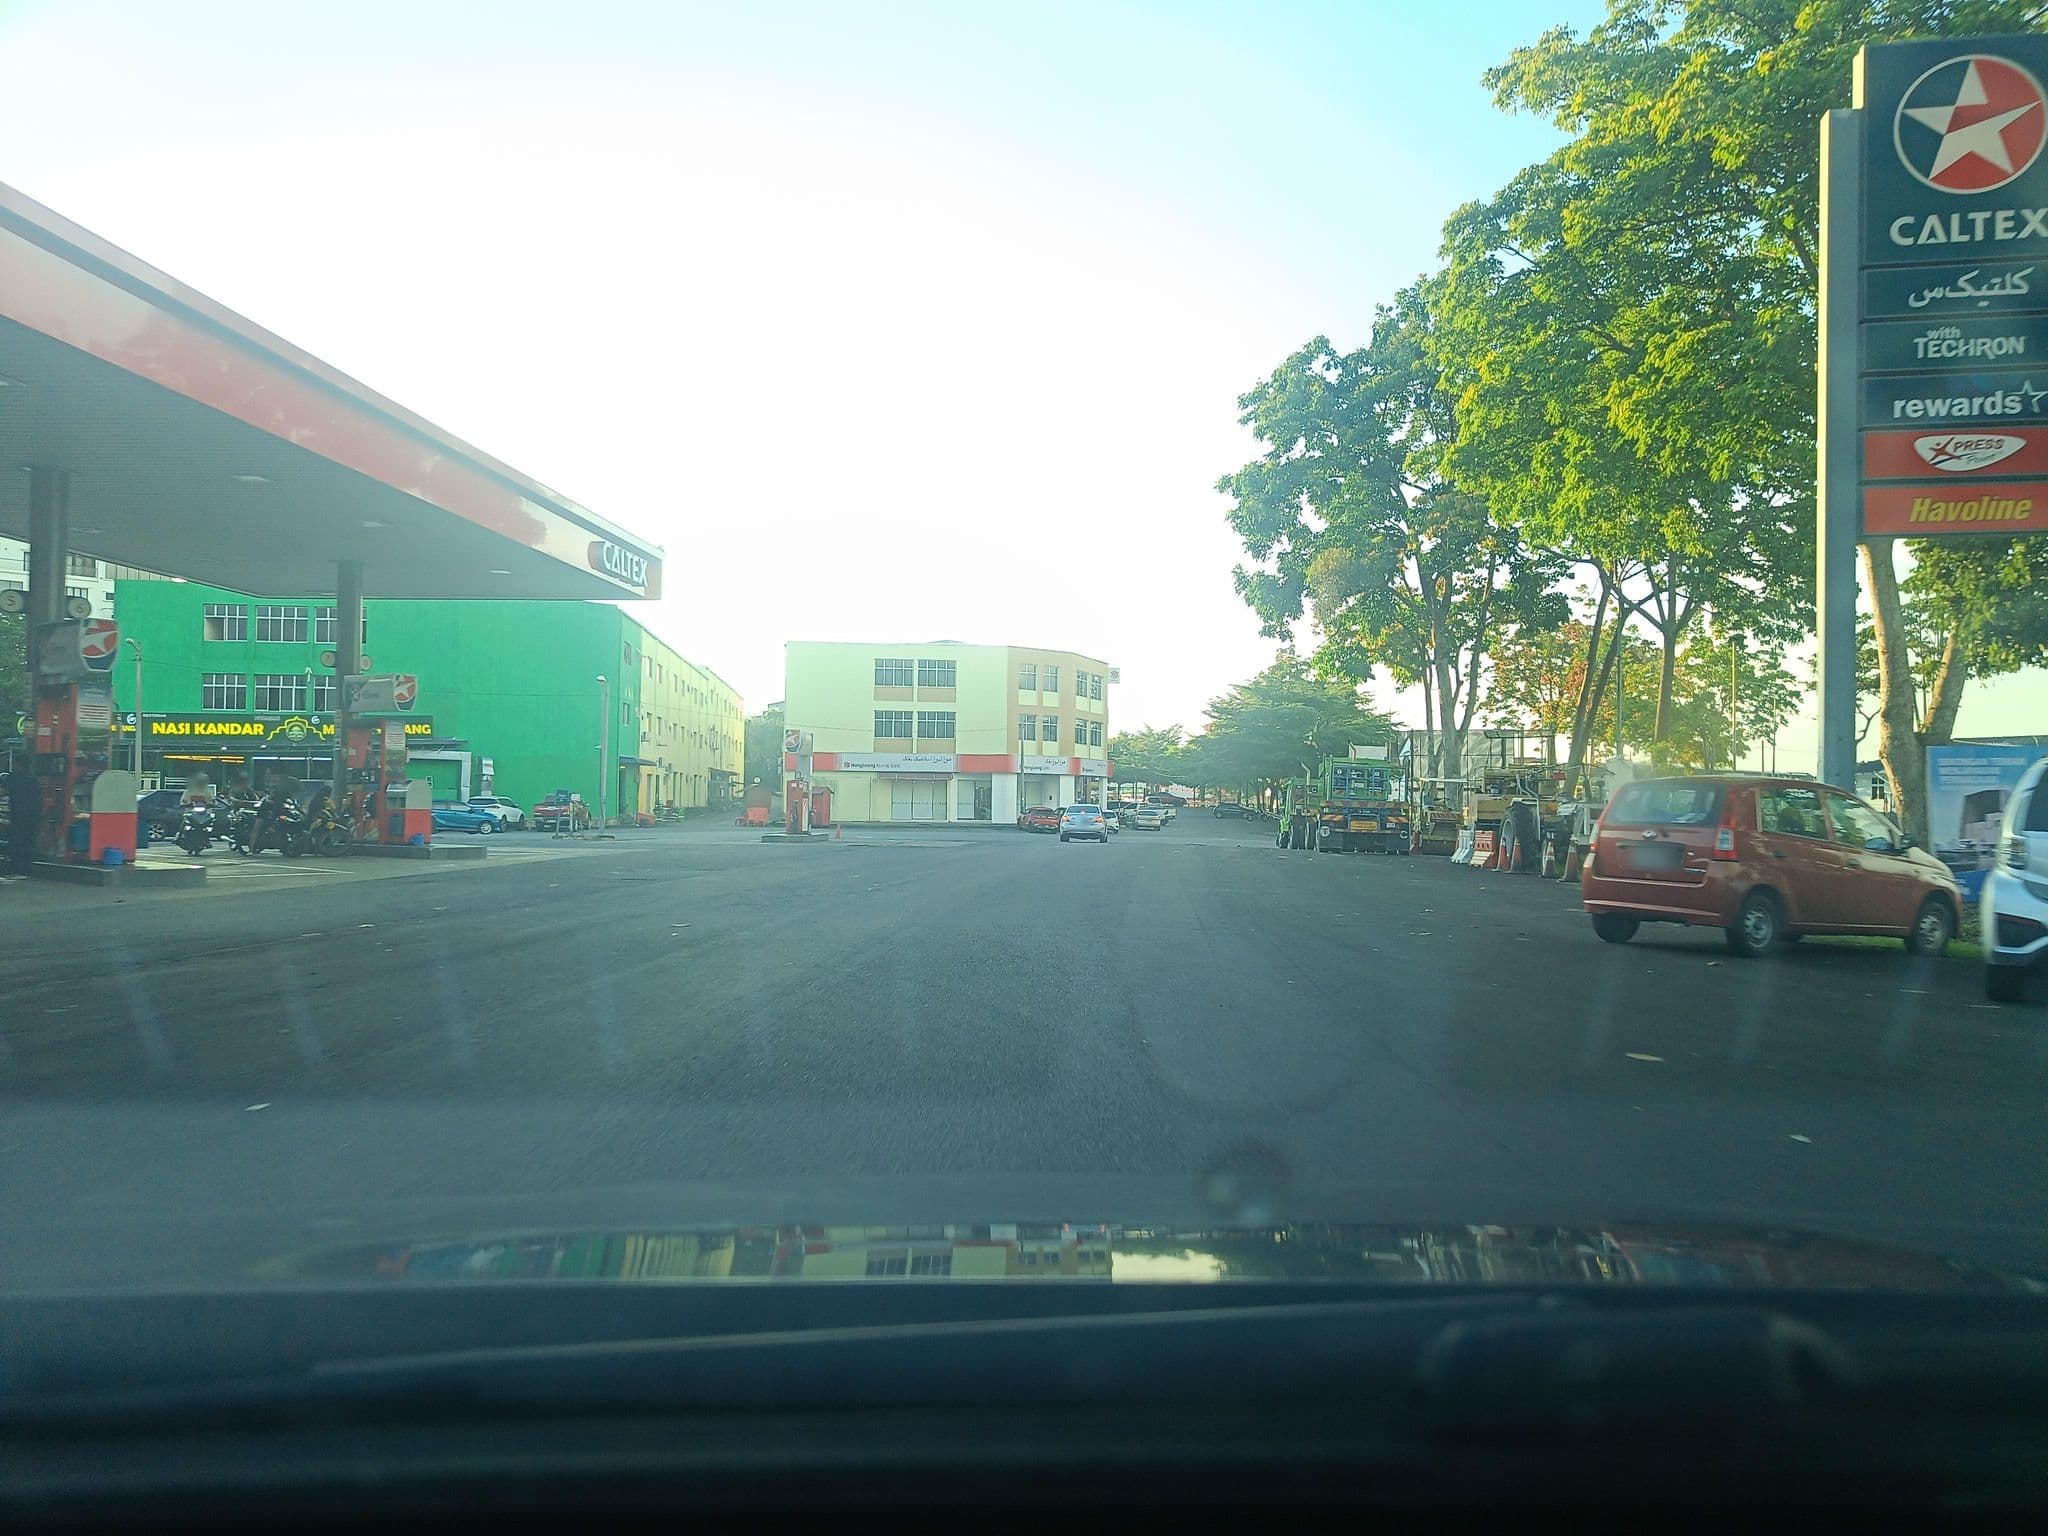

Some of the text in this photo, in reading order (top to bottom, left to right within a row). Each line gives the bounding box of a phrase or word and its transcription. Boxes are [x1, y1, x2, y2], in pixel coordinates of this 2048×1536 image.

[1889, 207, 2048, 246] CALTEX
[1926, 326, 1961, 340] with
[1913, 335, 2026, 360] TECHRON
[1893, 390, 2023, 419] rewards
[1909, 495, 2034, 523] Havoline
[603, 541, 648, 587] CALTEX
[152, 722, 265, 735] NASI KANDAR
